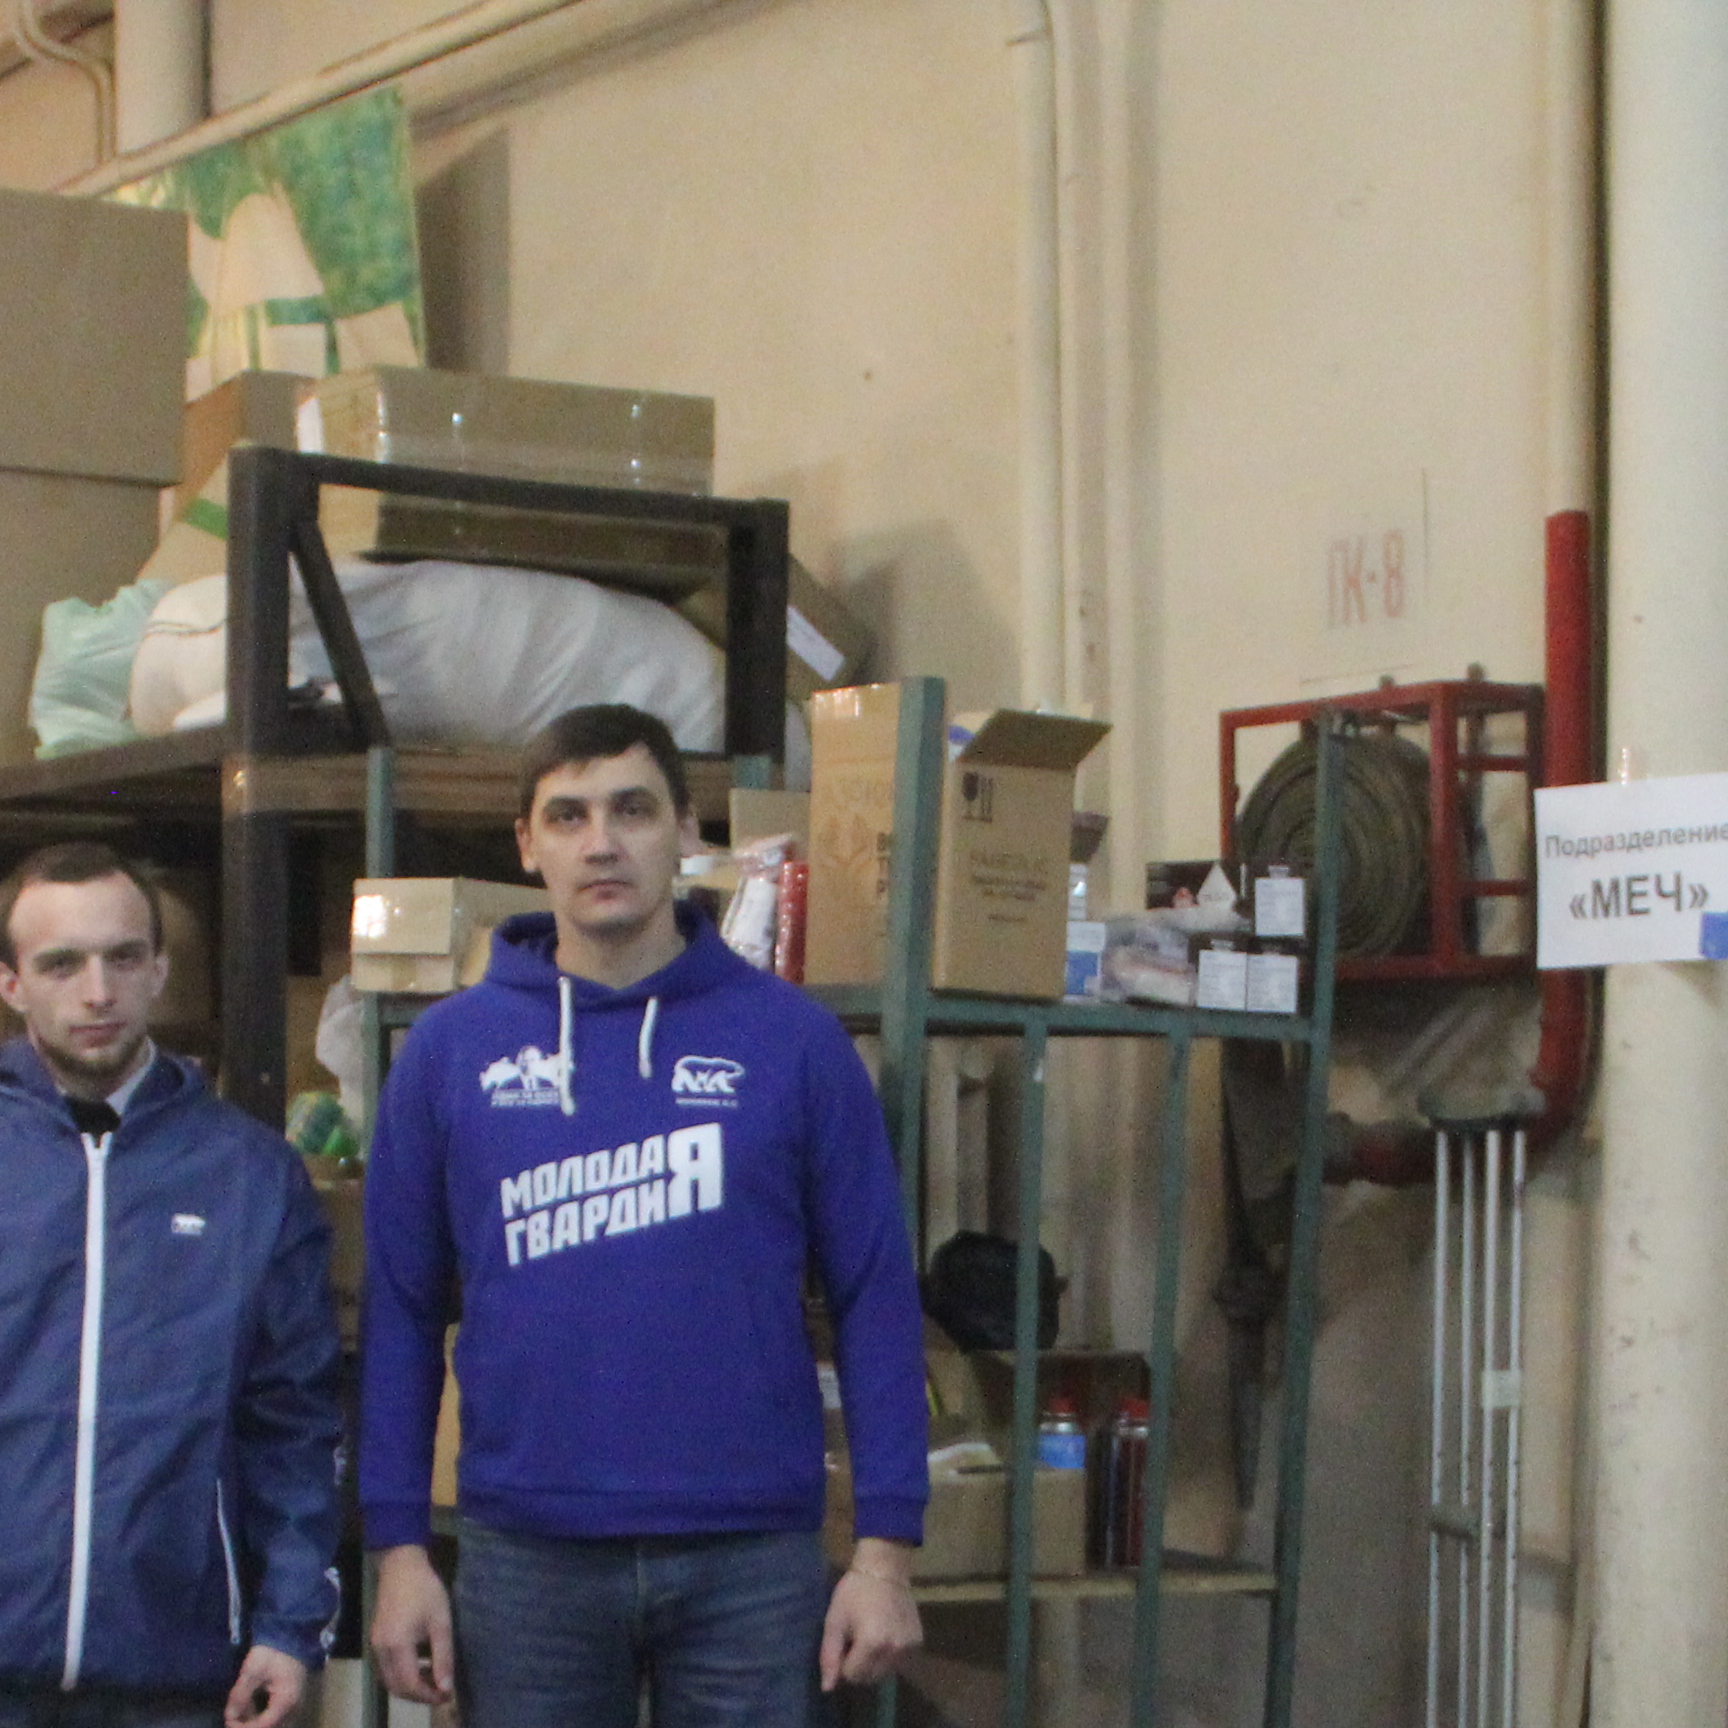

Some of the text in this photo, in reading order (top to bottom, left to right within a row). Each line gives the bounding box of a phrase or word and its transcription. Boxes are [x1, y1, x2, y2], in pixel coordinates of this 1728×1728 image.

[1568, 871, 1710, 920] «МЕЧ»
[500, 1121, 725, 1220] МОЛОДАЯ
[504, 1121, 725, 1268] ГВАРДИЯ
